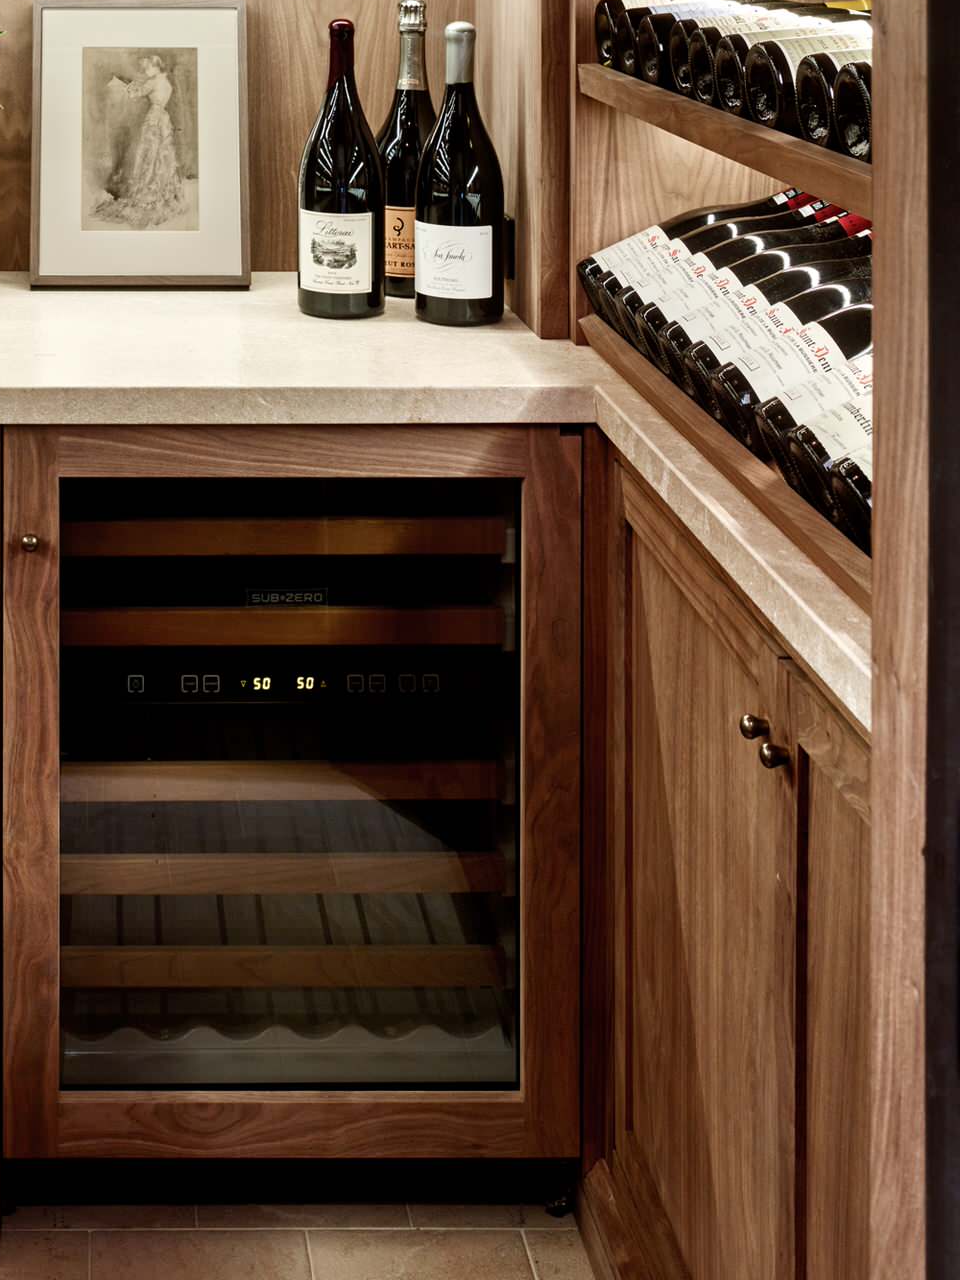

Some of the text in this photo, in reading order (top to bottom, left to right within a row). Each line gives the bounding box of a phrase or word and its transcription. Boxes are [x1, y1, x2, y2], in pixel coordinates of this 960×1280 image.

[386, 241, 415, 250] ART-SA
[253, 676, 315, 690] 50 50
